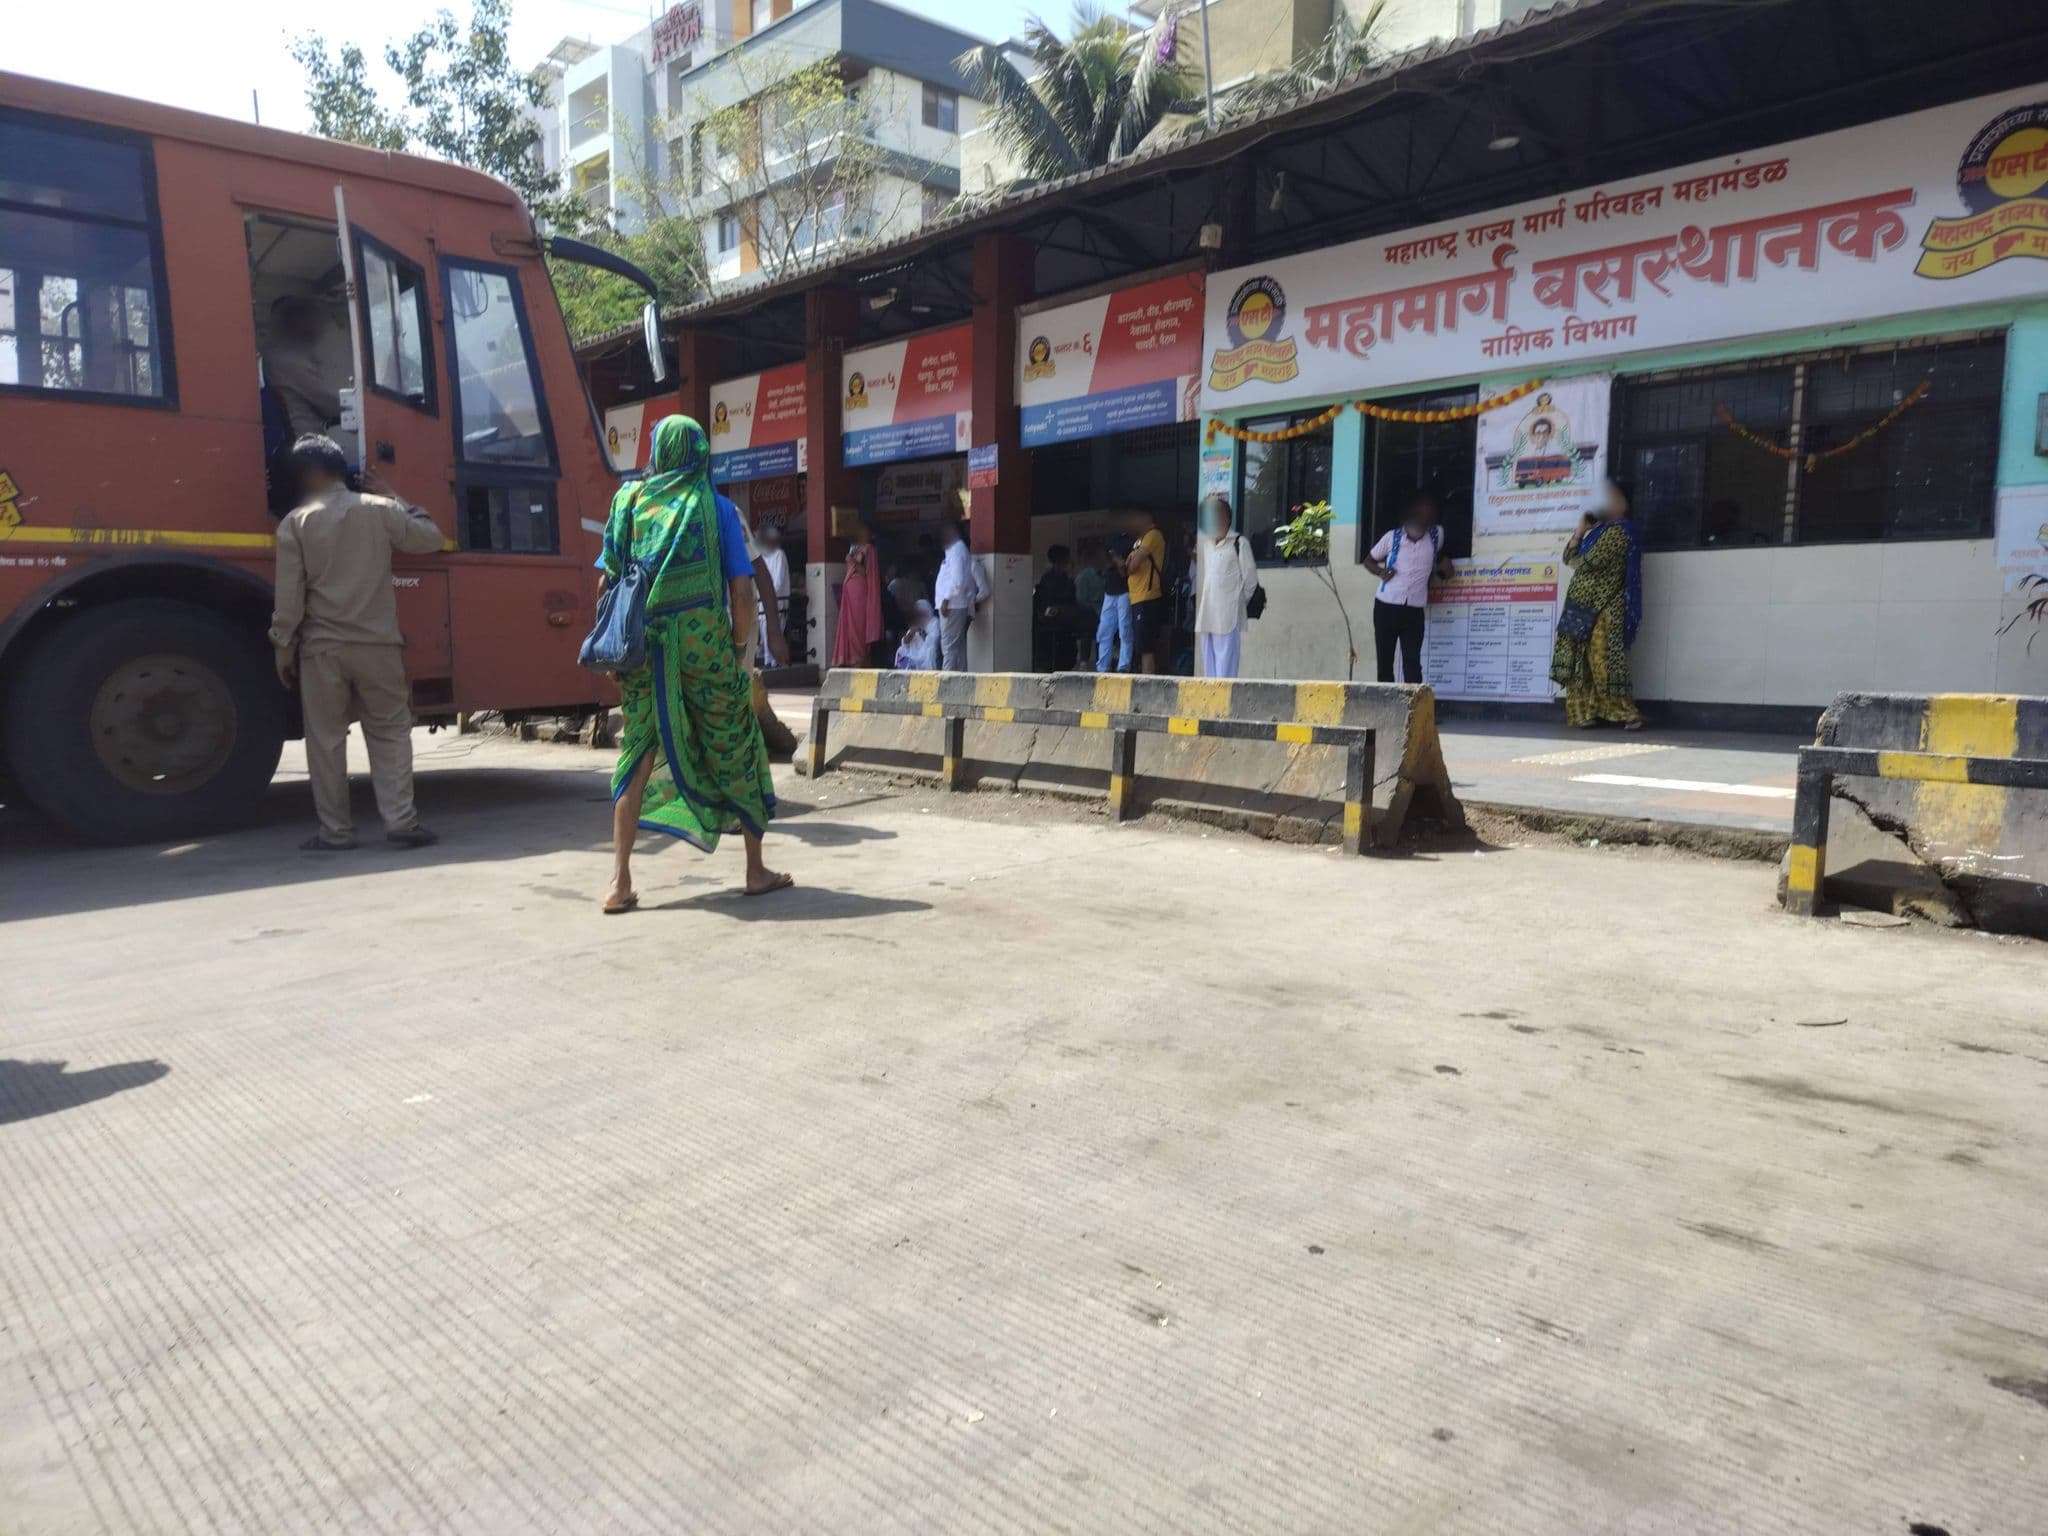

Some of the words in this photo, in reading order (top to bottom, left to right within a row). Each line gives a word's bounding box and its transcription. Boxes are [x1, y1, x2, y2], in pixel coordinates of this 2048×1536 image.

[1384, 231, 1459, 264] महाराष्ट्र
[1466, 220, 1514, 248] राज्य
[1523, 198, 1567, 235] मार्ग
[1575, 185, 1663, 223] परिवहन
[1673, 157, 1790, 202] महामंडळ
[1930, 213, 1995, 244] महाराष्ट्र
[1303, 242, 1521, 360] महामार्ग
[1532, 186, 1915, 308] बसस्थानक
[1942, 249, 1977, 272] जय
[1083, 332, 1093, 355] ६
[1482, 325, 1553, 358] नाशिक
[1563, 315, 1638, 347] विभाग
[888, 370, 896, 391] ५
